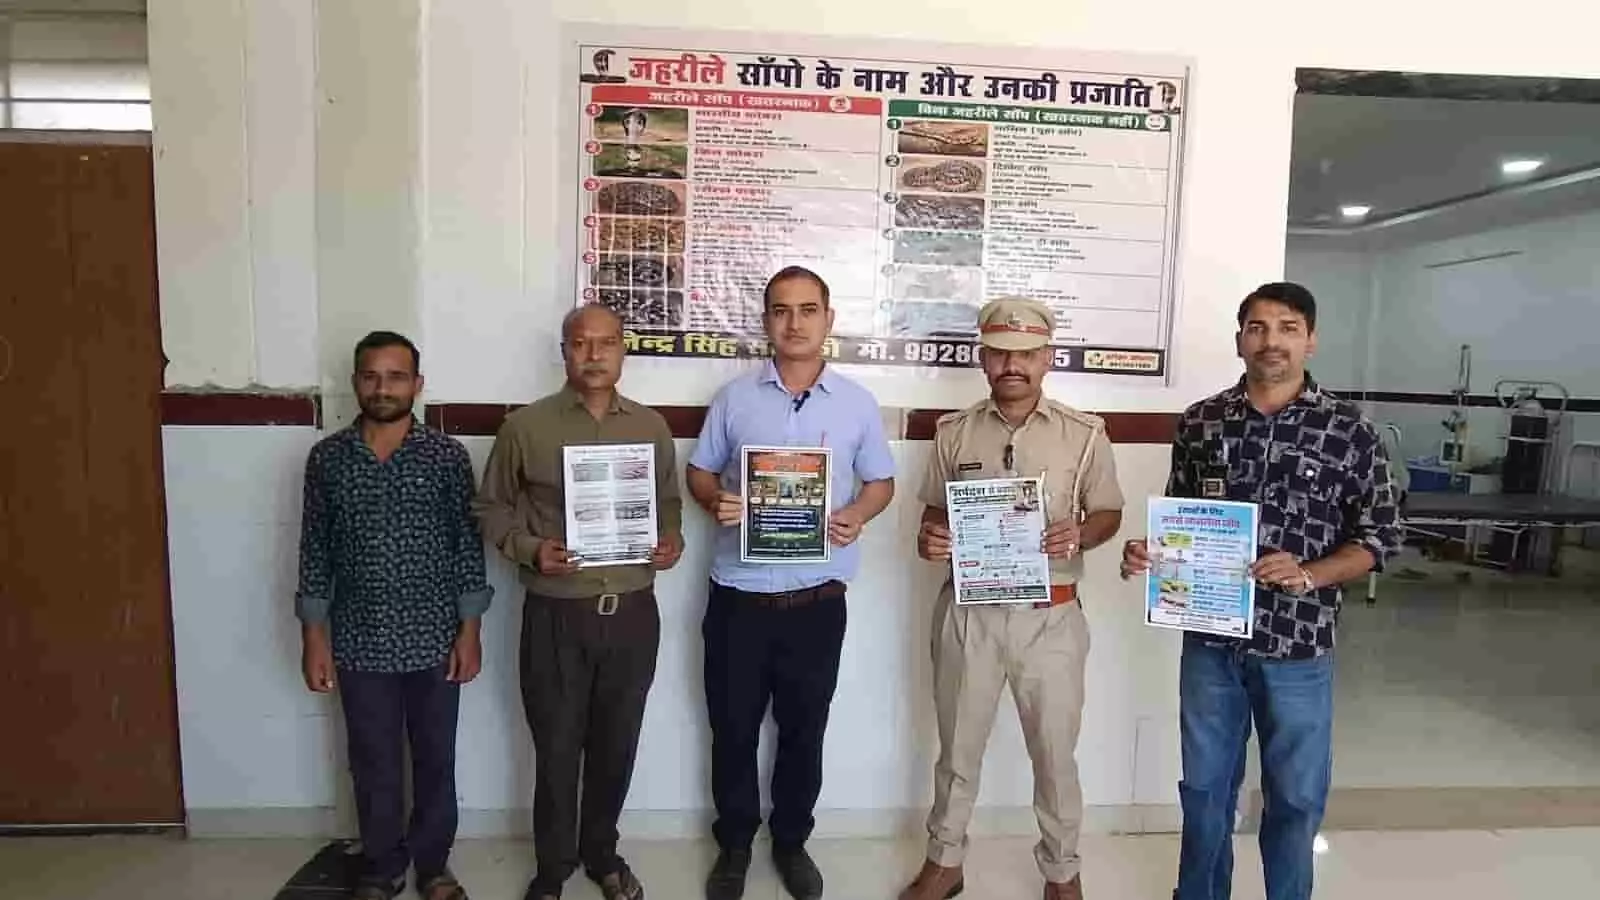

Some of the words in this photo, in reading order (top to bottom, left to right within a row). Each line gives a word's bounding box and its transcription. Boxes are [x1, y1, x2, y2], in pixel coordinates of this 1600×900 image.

[629, 53, 727, 85] जहरीले
[815, 60, 844, 90] के
[853, 67, 910, 94] नाम
[919, 66, 974, 97] और
[984, 73, 1060, 104] उनकी
[1069, 78, 1154, 108] प्रजाति
[648, 91, 699, 104] जहरीले
[917, 102, 948, 116] बिना
[951, 105, 999, 120] जहरीले
[684, 332, 738, 357] सिंह
[857, 338, 896, 361] मो.
